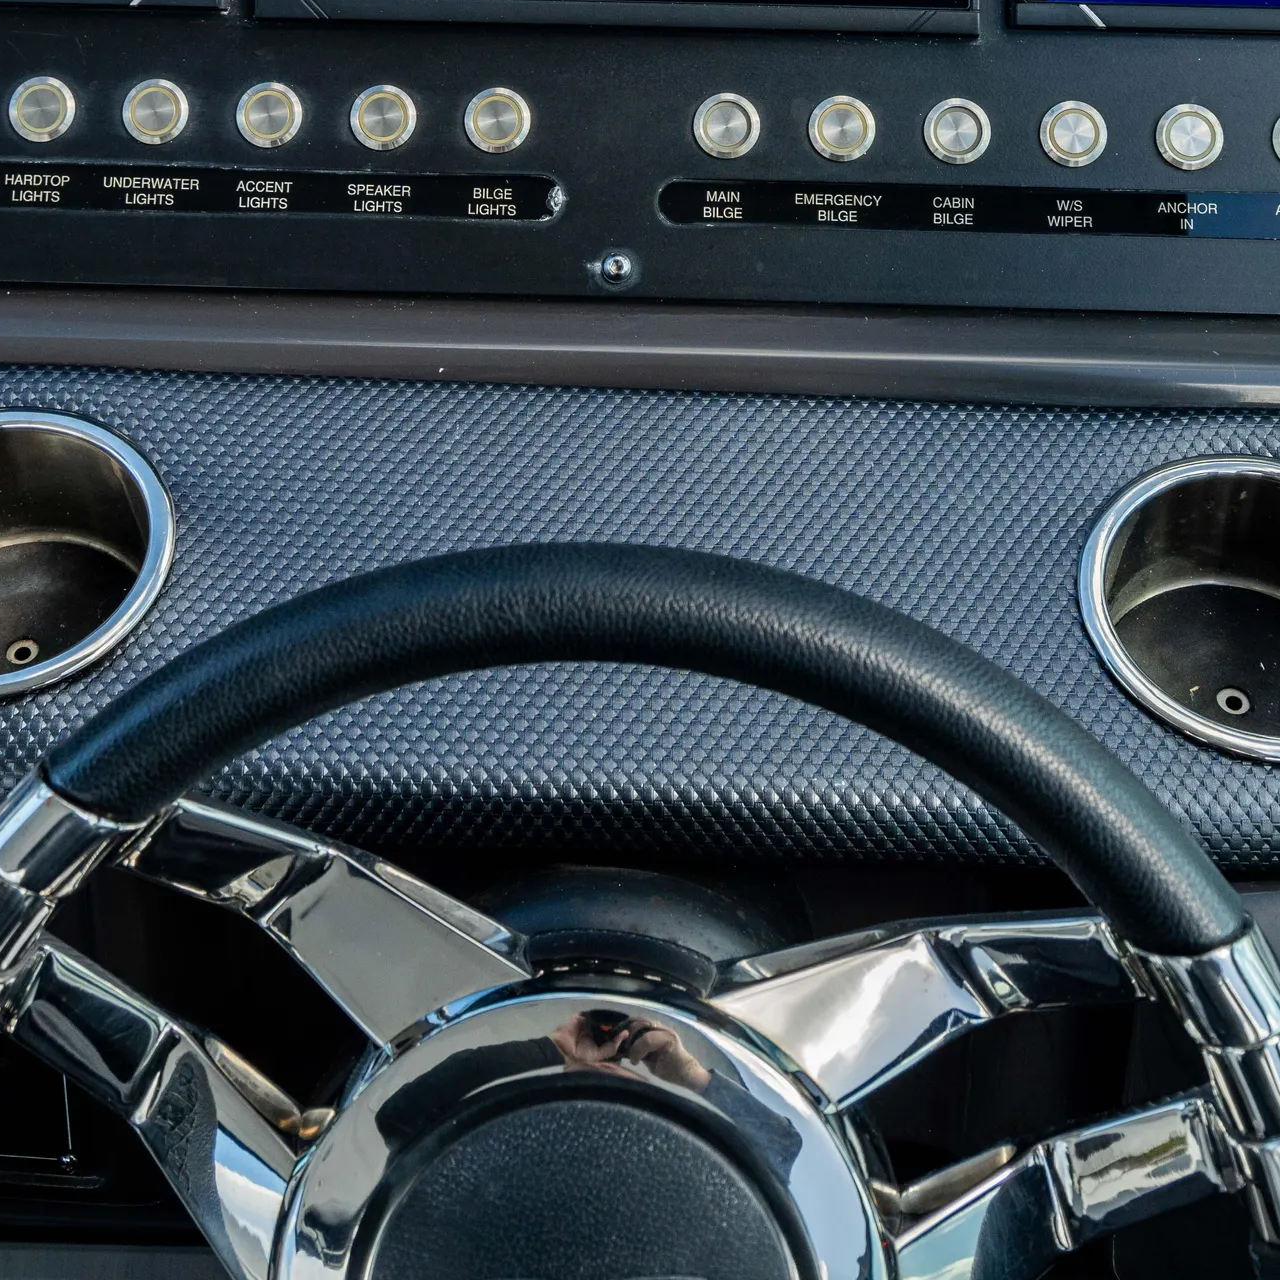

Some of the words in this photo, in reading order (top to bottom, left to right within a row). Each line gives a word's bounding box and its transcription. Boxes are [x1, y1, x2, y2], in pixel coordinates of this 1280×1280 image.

[5, 174, 70, 187] HARDTOP
[103, 176, 200, 191] UNDERWATER
[236, 180, 293, 193] ACCENT
[12, 190, 60, 203] LIGHTS
[347, 184, 411, 197] SPEAKER
[473, 188, 512, 200] BILGE
[706, 191, 740, 203] MAIN
[125, 193, 174, 206] LIGHTS
[238, 196, 288, 210] LIGHTS
[795, 193, 882, 207] EMERGENCY
[932, 197, 975, 209] CABIN
[1056, 199, 1083, 212] W/S
[354, 200, 403, 213] LIGHTS
[468, 204, 517, 217] LIGHTS
[703, 207, 743, 219] BILGE
[1157, 202, 1218, 215] ANCHOR
[818, 210, 857, 222] BILGE
[933, 213, 974, 225] BILGE
[1047, 214, 1093, 228] WIPER
[1180, 218, 1194, 230] IN
